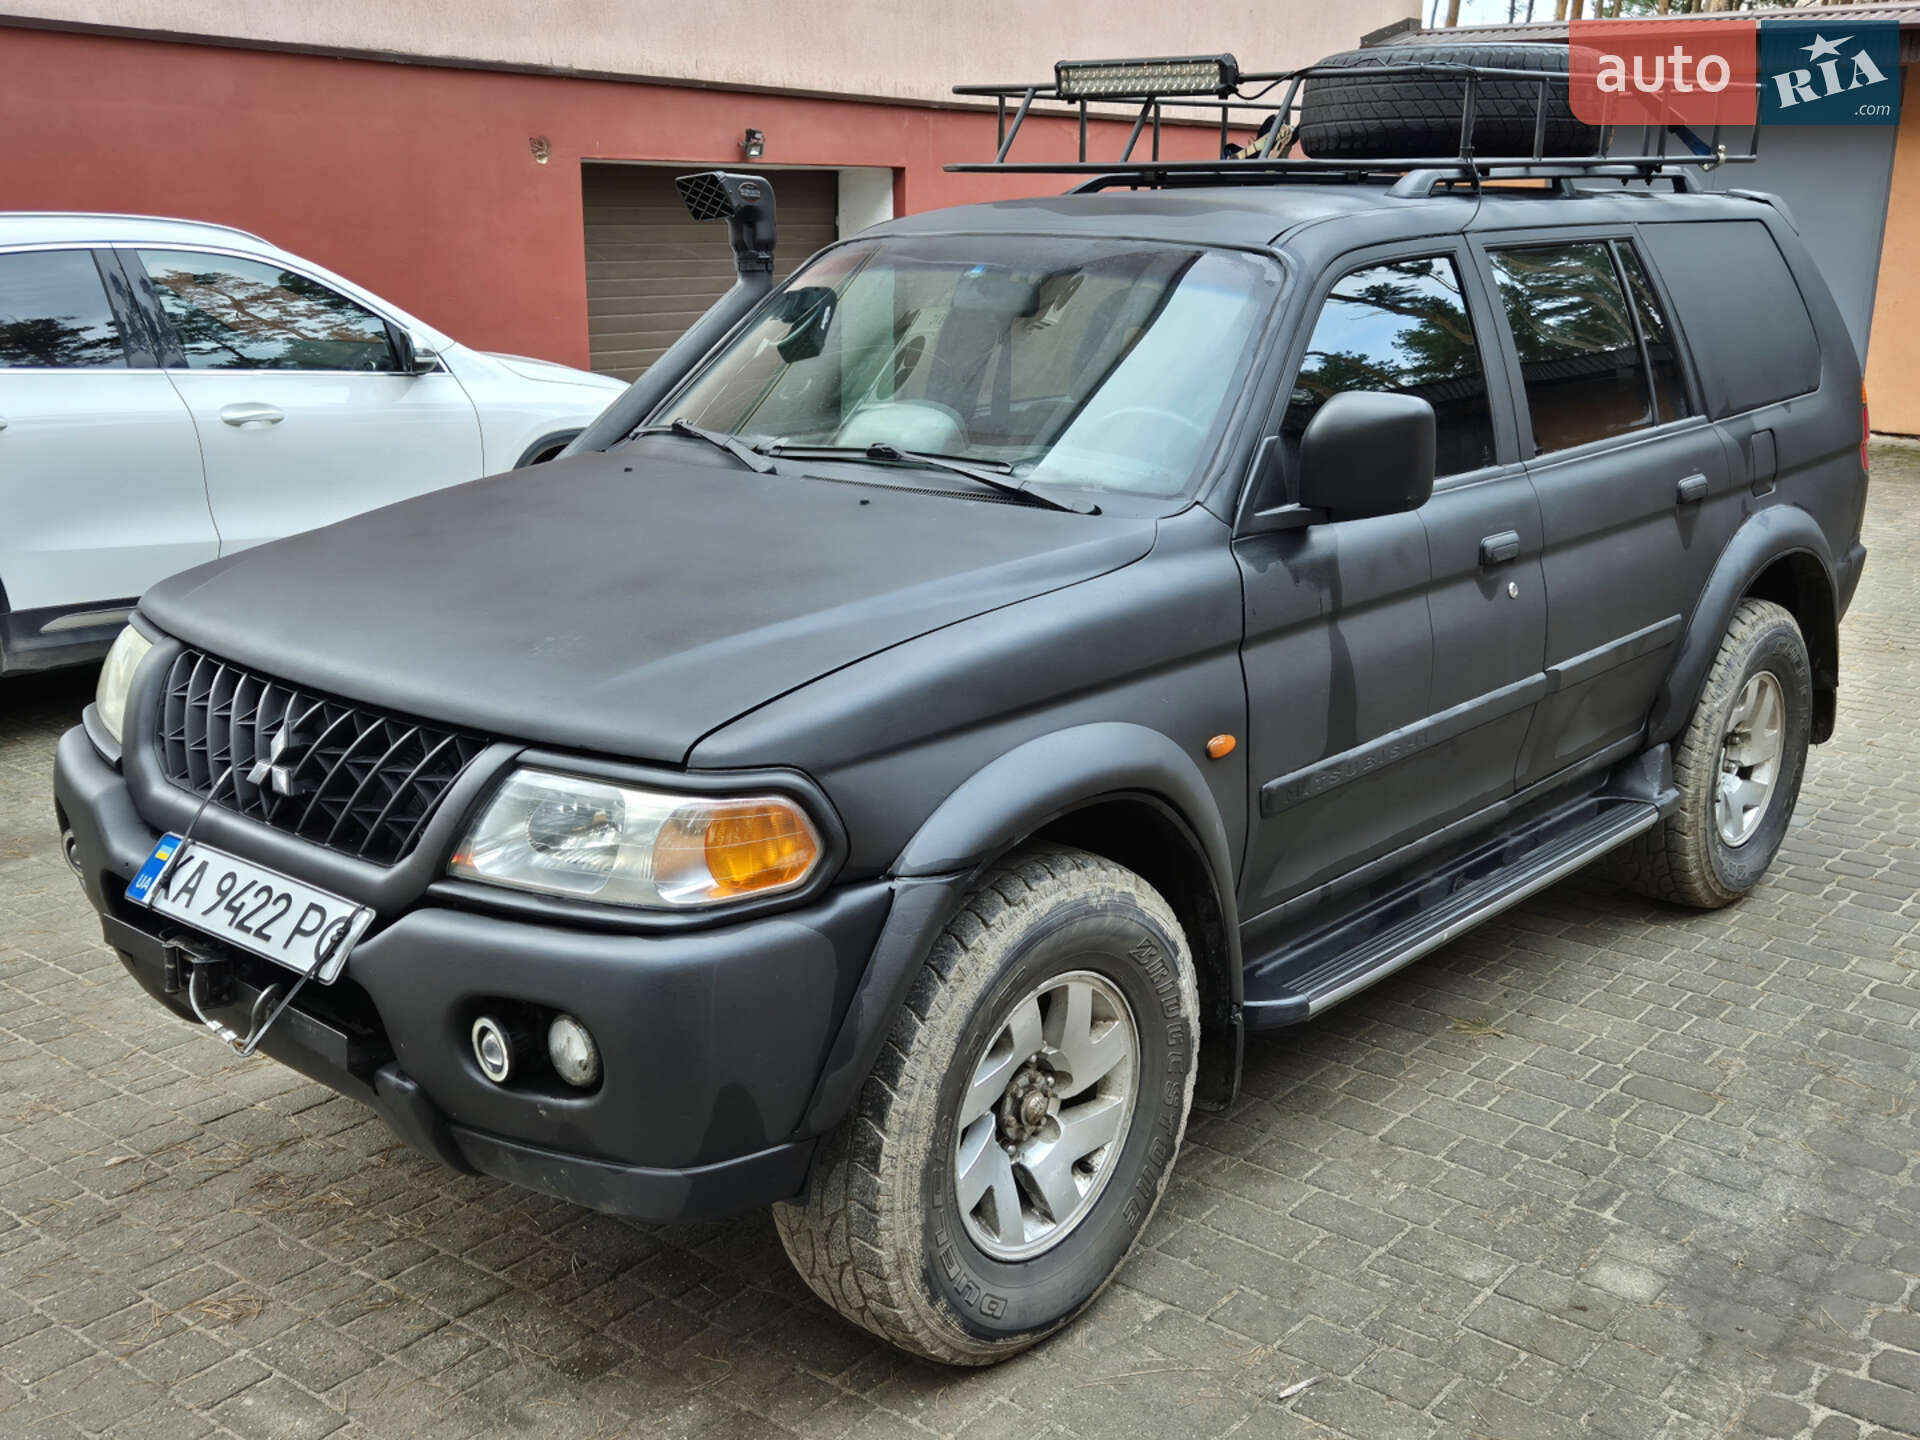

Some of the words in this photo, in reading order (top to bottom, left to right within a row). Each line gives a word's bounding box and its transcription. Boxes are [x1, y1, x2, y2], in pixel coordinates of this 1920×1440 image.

[135, 873, 153, 891] UA
[201, 871, 293, 943] 9422
[1122, 937, 1185, 1228] BRIDGESTONE
